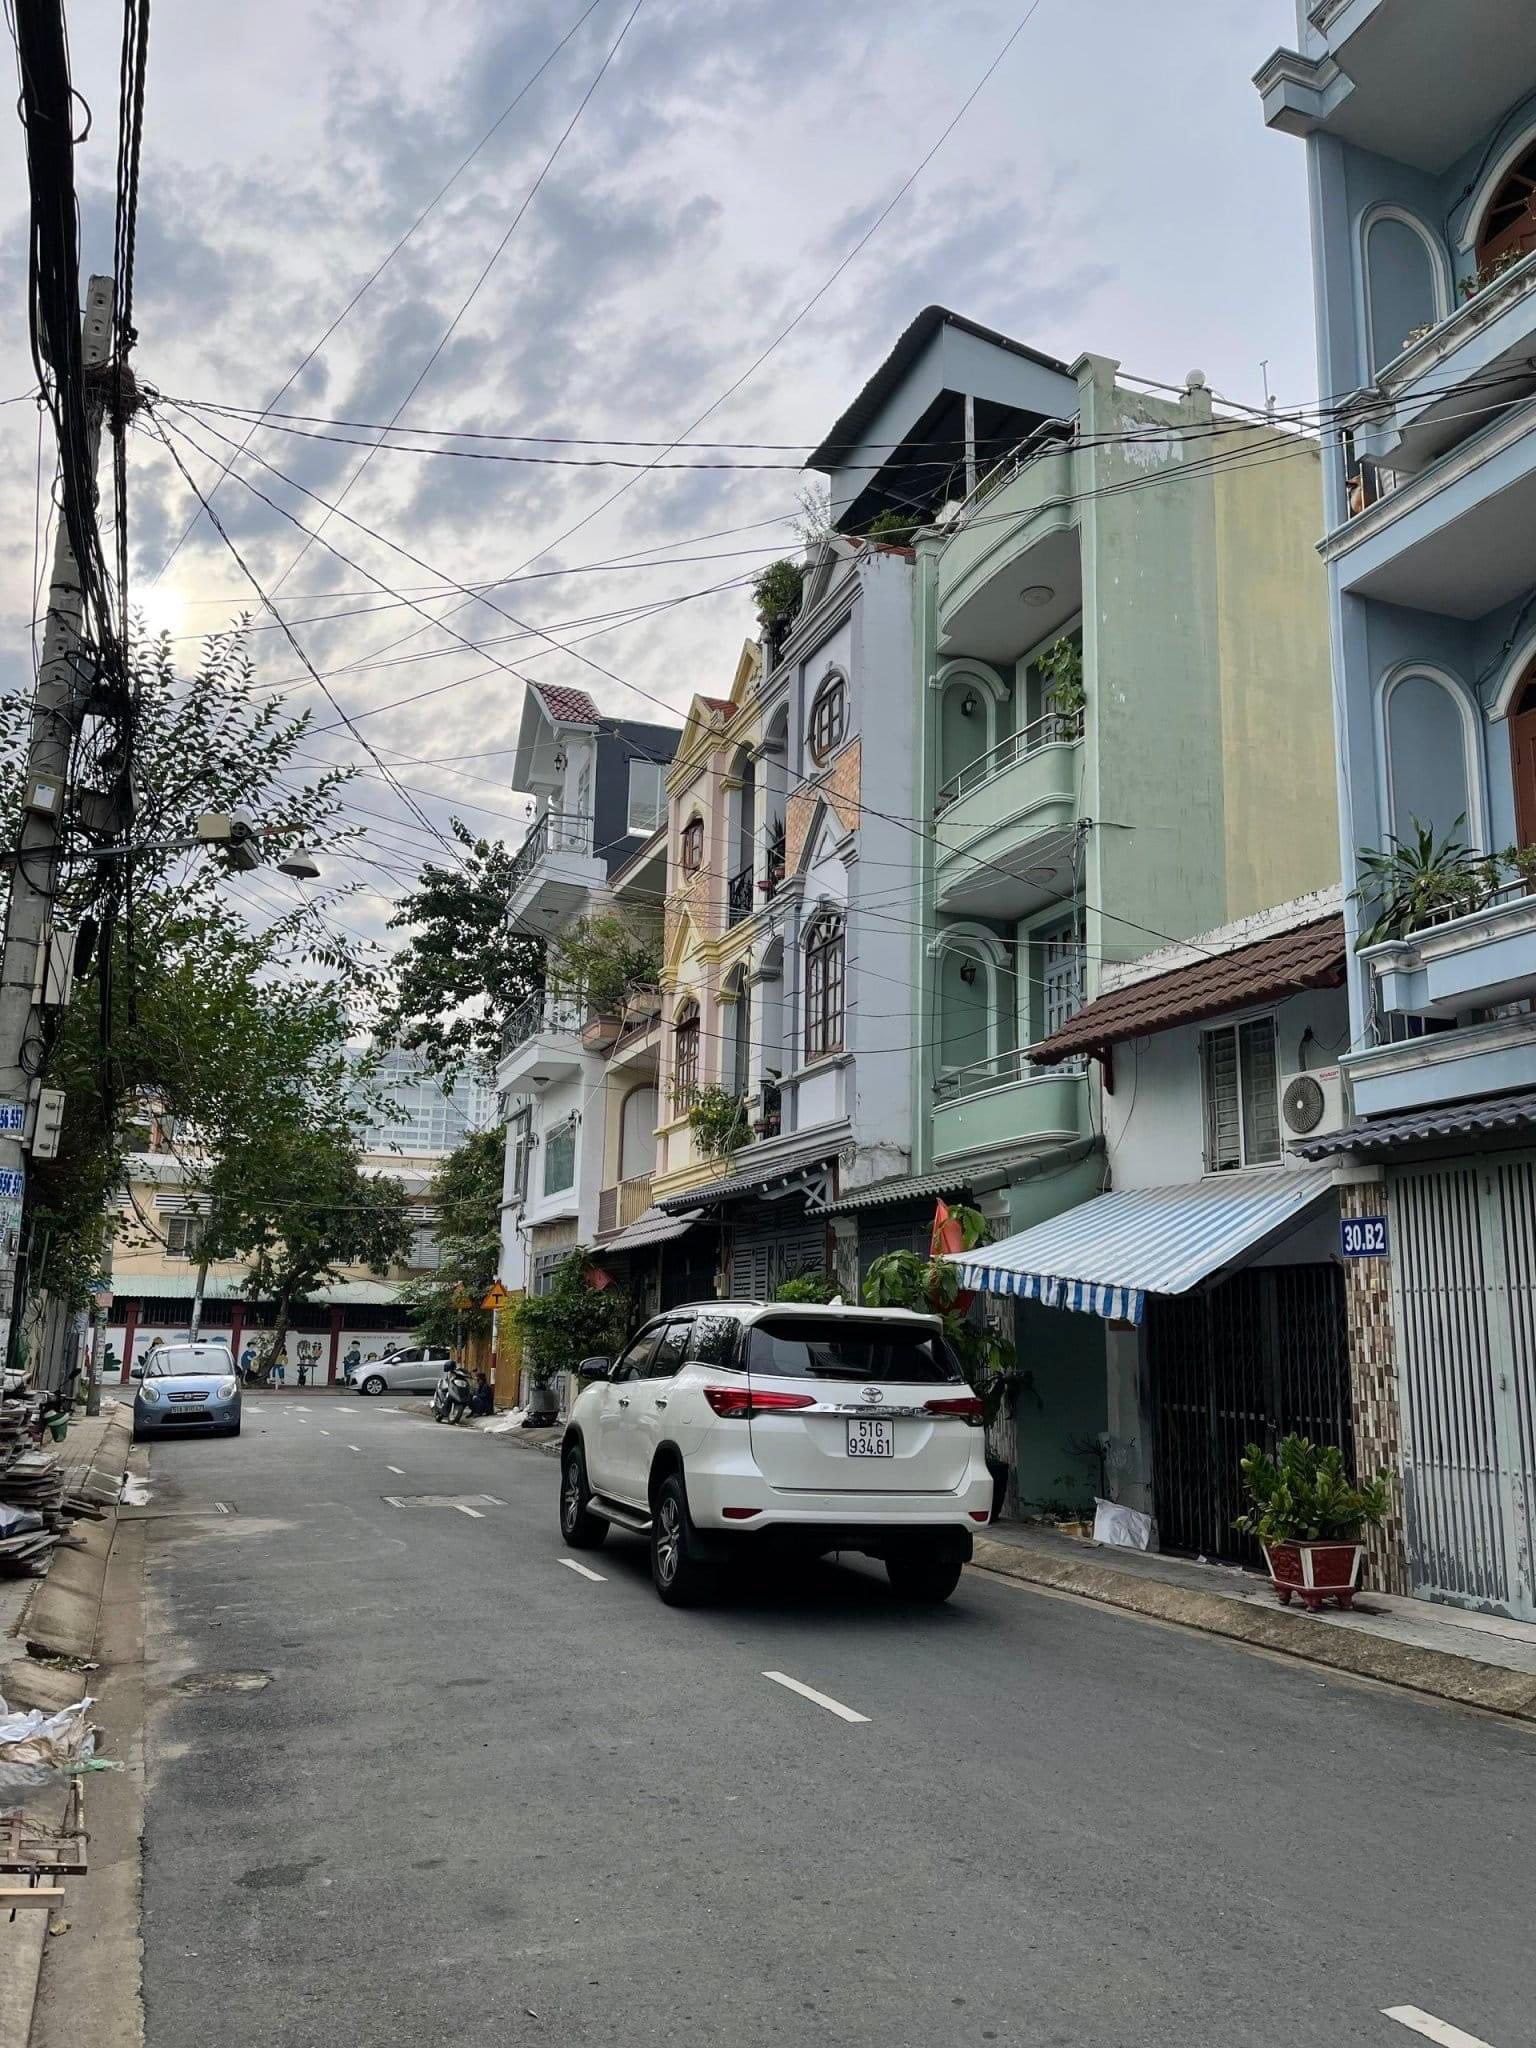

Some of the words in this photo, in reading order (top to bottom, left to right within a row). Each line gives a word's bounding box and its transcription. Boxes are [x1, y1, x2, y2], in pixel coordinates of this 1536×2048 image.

[1344, 1222, 1385, 1251] 30.B2
[859, 1421, 883, 1438] 51G
[849, 1438, 890, 1455] 934.61
